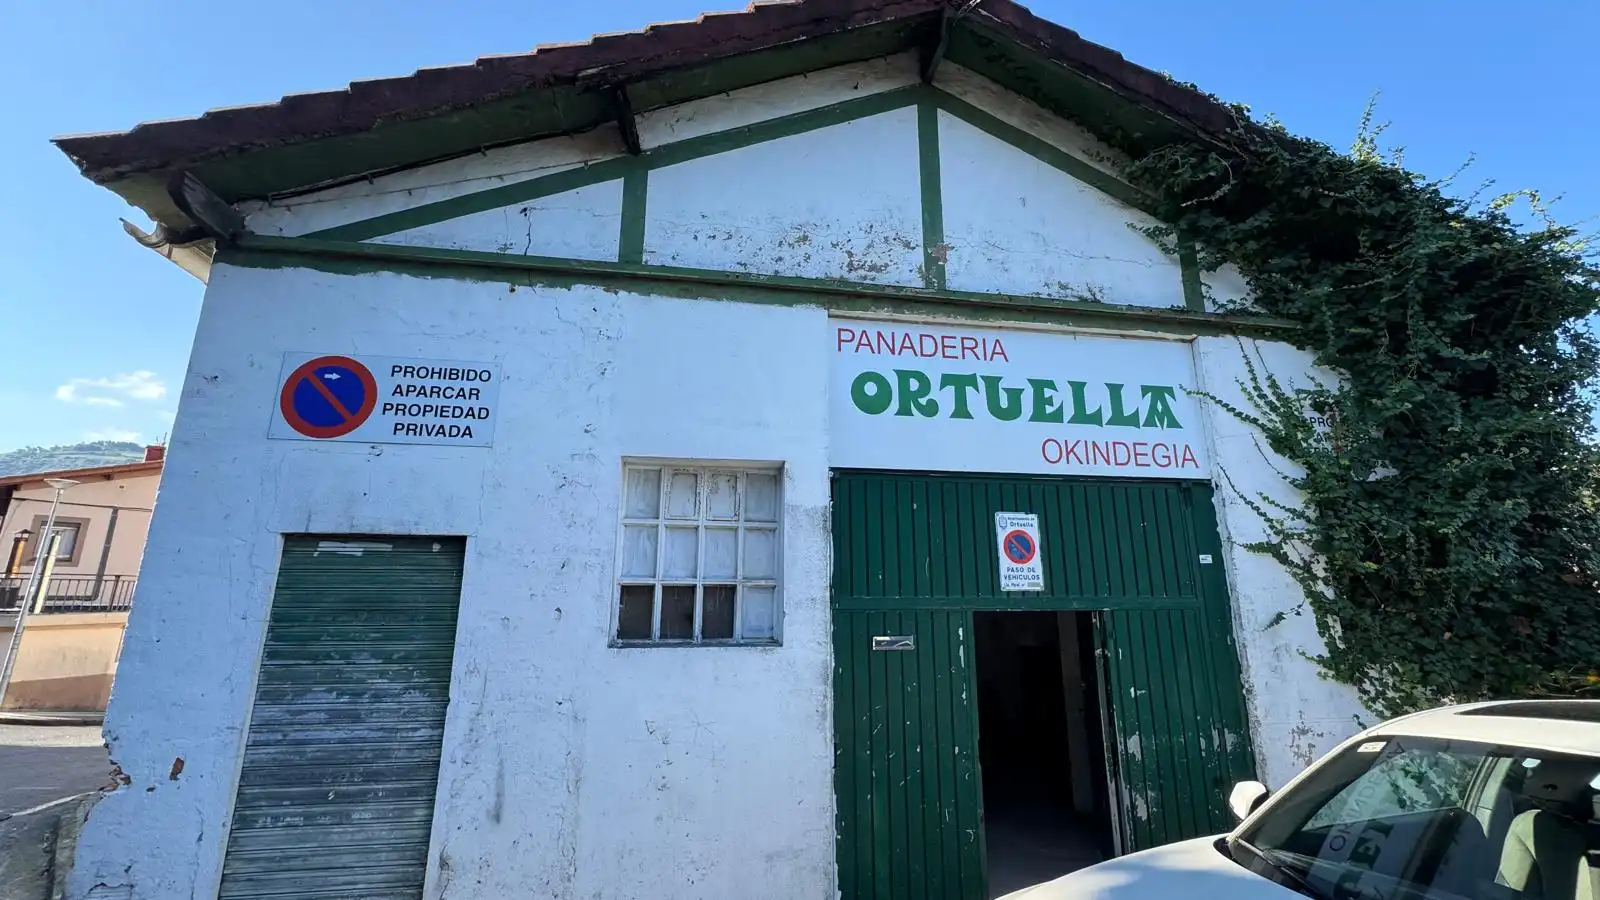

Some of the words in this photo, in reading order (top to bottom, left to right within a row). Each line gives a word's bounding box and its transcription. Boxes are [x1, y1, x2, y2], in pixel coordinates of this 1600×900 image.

[836, 327, 1009, 362] PANADERIA
[390, 364, 492, 382] PROHIBIDO
[391, 384, 481, 401] APARCAR
[850, 368, 1183, 430] ORTUELLA
[381, 402, 490, 420] PROPIEDAD
[392, 422, 473, 438] PRIVADA
[1309, 416, 1334, 428] PRO
[1041, 438, 1199, 468] OKINDEGIA
